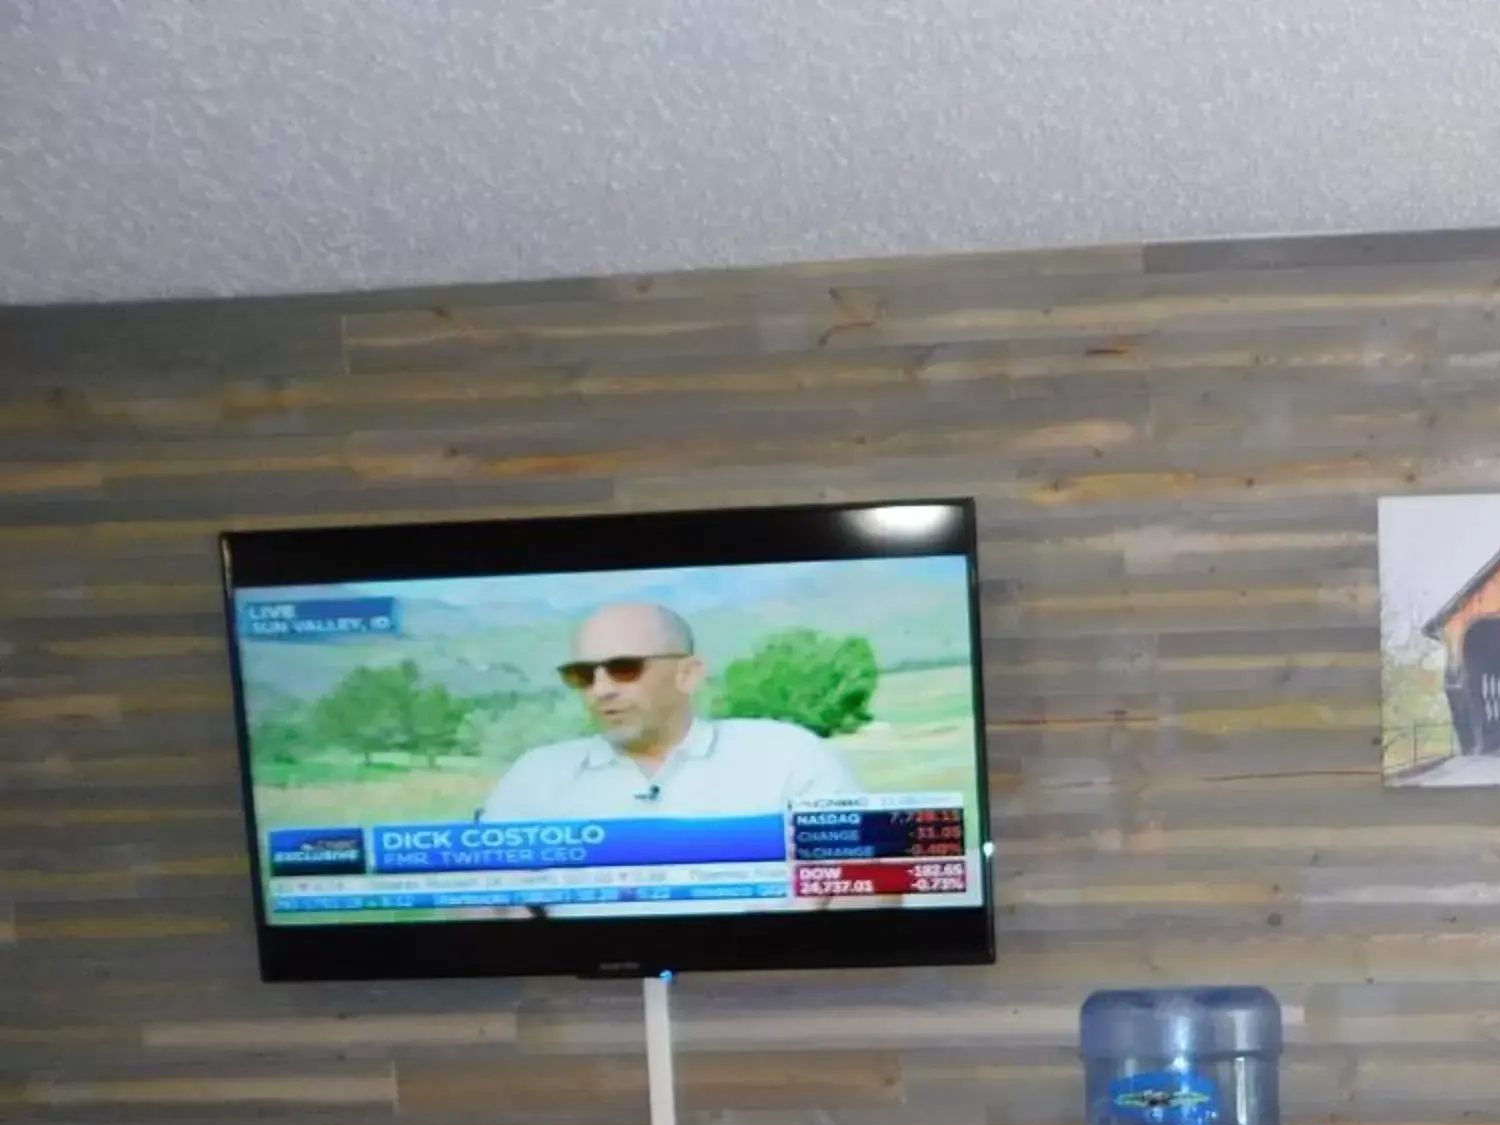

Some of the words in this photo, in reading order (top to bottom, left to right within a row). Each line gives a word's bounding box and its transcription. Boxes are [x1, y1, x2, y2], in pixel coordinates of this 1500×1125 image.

[796, 812, 862, 826] NASDAQ
[382, 829, 452, 850] DICK
[460, 824, 606, 848] COSTOLO
[797, 828, 860, 842] CHANGE
[440, 847, 537, 867] TWITTER
[540, 846, 589, 863] CEO
[799, 866, 843, 880] DOW
